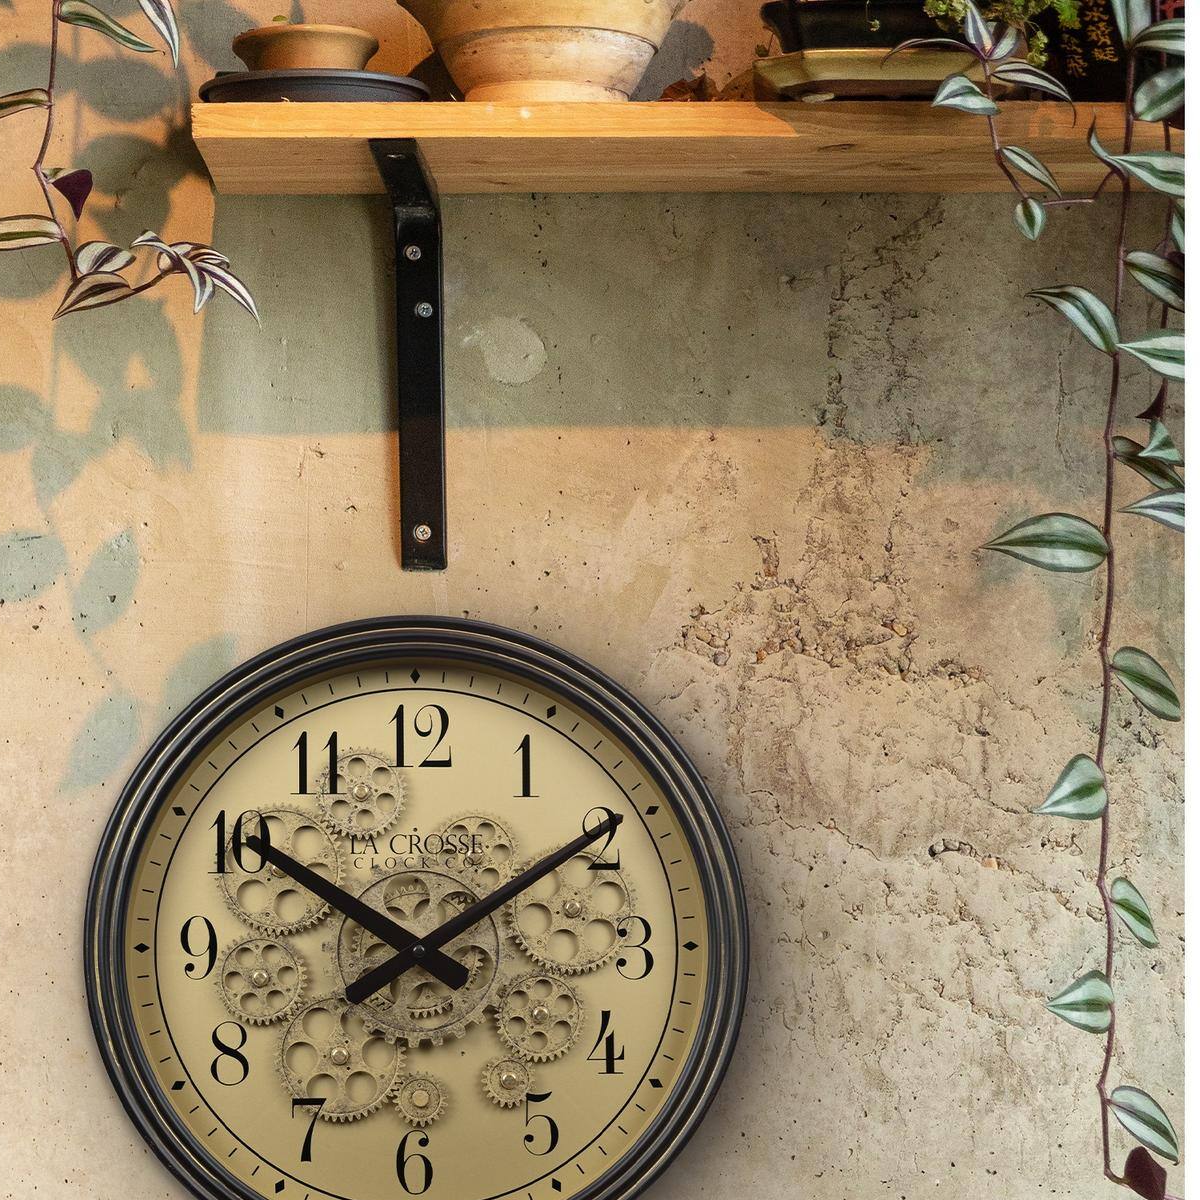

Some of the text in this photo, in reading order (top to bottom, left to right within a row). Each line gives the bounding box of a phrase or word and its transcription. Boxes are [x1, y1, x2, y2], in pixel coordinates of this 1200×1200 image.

[290, 731, 347, 795] 11
[388, 704, 453, 768] 12
[513, 734, 540, 798] 1
[208, 809, 271, 874] 10
[350, 833, 483, 855] LA CROSSE
[582, 806, 621, 871] 2
[179, 915, 218, 980] 9
[616, 916, 654, 981] 3
[210, 1021, 250, 1086] 8
[585, 1010, 625, 1075] 4
[291, 1098, 326, 1163] 7
[523, 1091, 560, 1156] 5
[396, 1129, 434, 1195] 6
